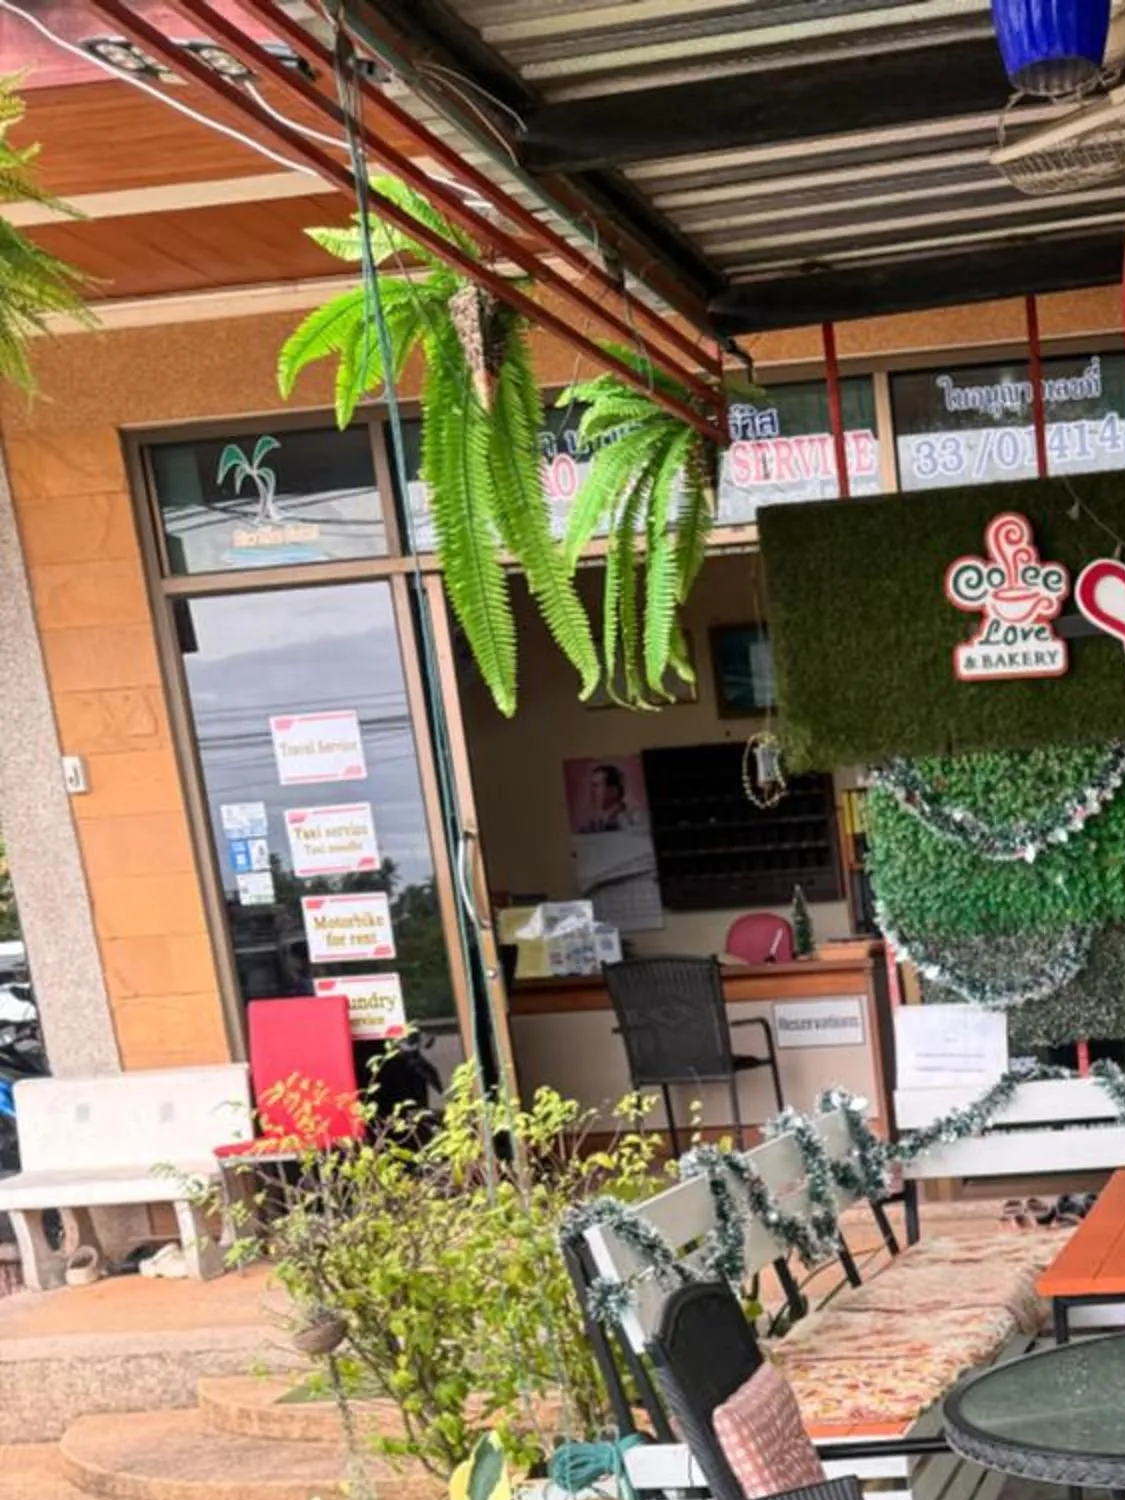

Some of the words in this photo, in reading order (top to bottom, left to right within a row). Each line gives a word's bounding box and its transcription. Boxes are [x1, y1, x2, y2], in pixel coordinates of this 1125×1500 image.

[731, 432, 875, 485] SERVIE
[978, 618, 1050, 646] Love
[963, 654, 976, 670] &
[982, 650, 1058, 670] BAKERY
[313, 911, 385, 929] Motorbike
[326, 931, 346, 946] for
[350, 931, 378, 945] rent
[778, 1015, 860, 1032] Reservations
